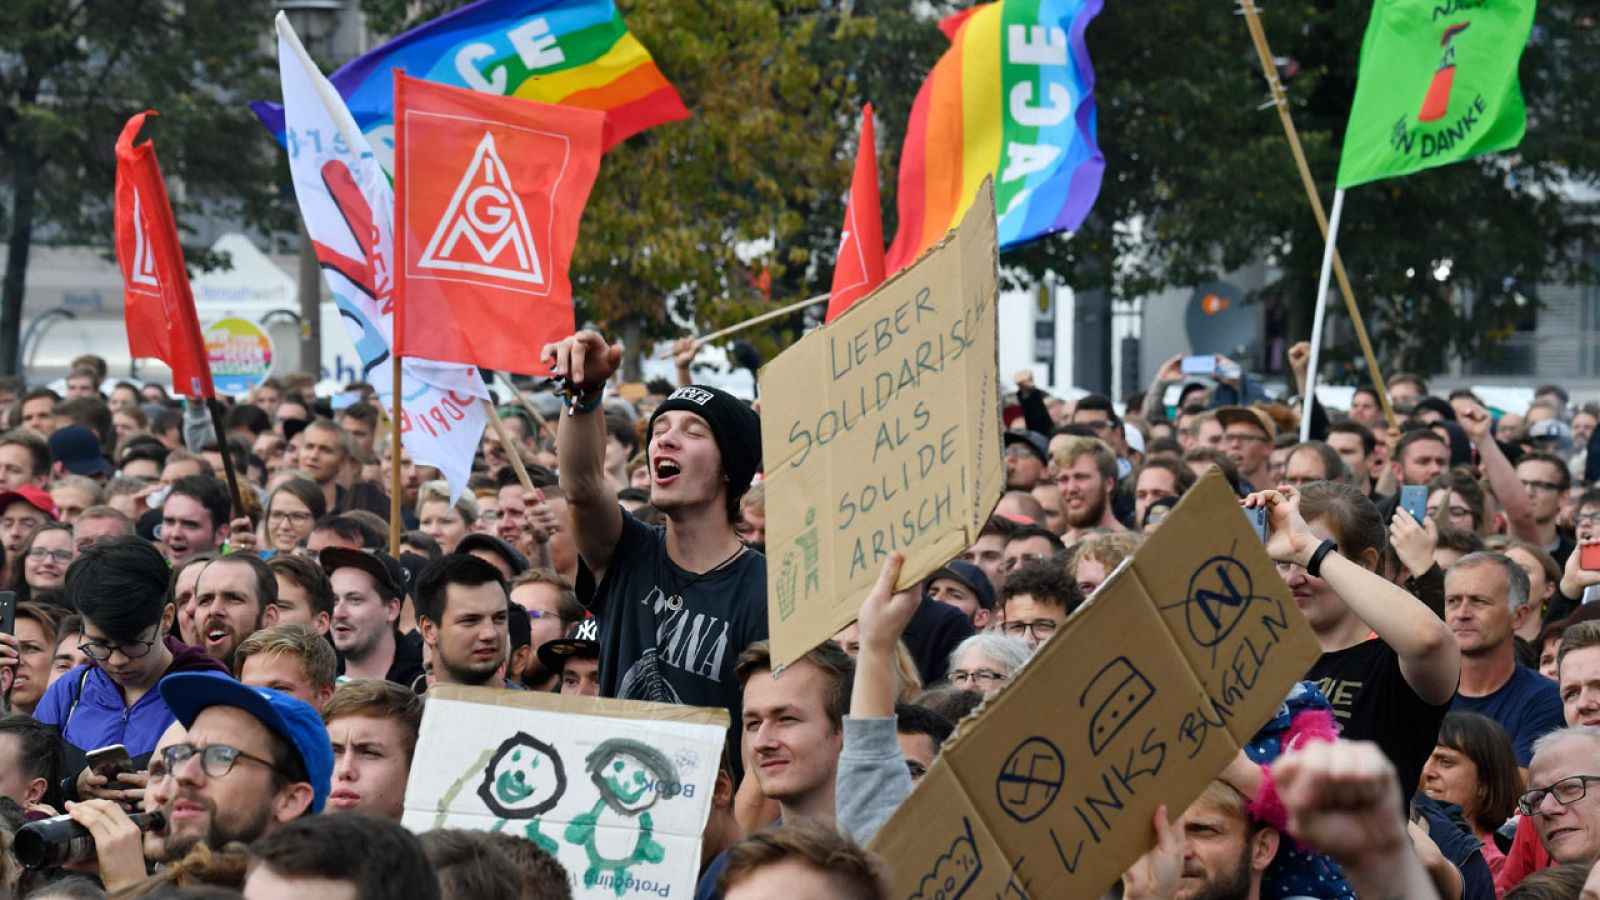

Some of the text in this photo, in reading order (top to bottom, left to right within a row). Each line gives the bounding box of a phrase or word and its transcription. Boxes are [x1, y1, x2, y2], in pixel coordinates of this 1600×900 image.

[997, 24, 1071, 215] ACE
[1421, 93, 1487, 159] DANKE
[788, 284, 986, 468] SOLIDARISCH
[830, 286, 936, 382] LIEBER
[839, 424, 960, 530] SOLIDE
[872, 401, 930, 463] ALS
[1050, 727, 1167, 875] LINKS
